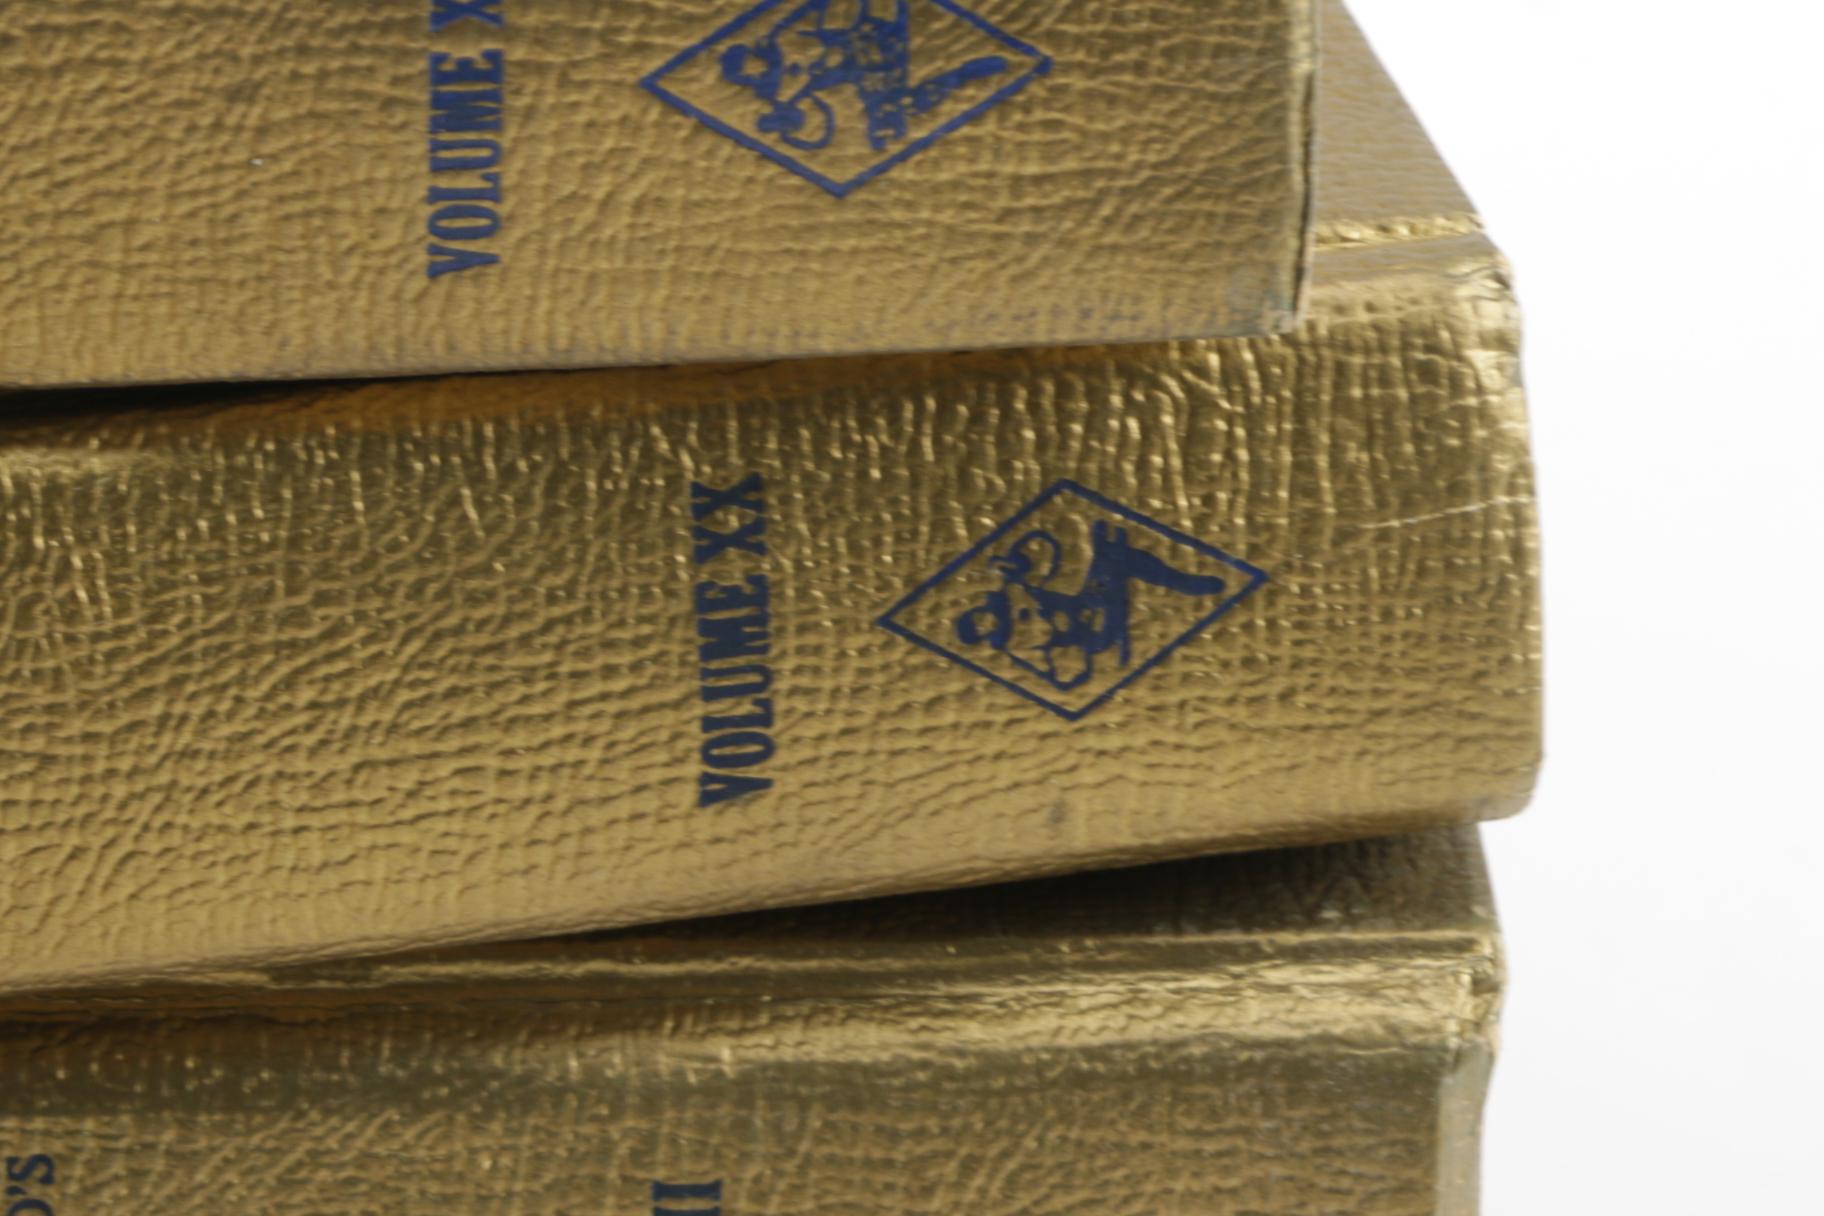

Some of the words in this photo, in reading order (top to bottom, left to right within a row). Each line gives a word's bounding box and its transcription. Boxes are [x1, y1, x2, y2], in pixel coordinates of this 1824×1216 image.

[425, 48, 506, 279] VOLUME
[688, 473, 769, 566] XX
[693, 573, 776, 808] VOLUME
